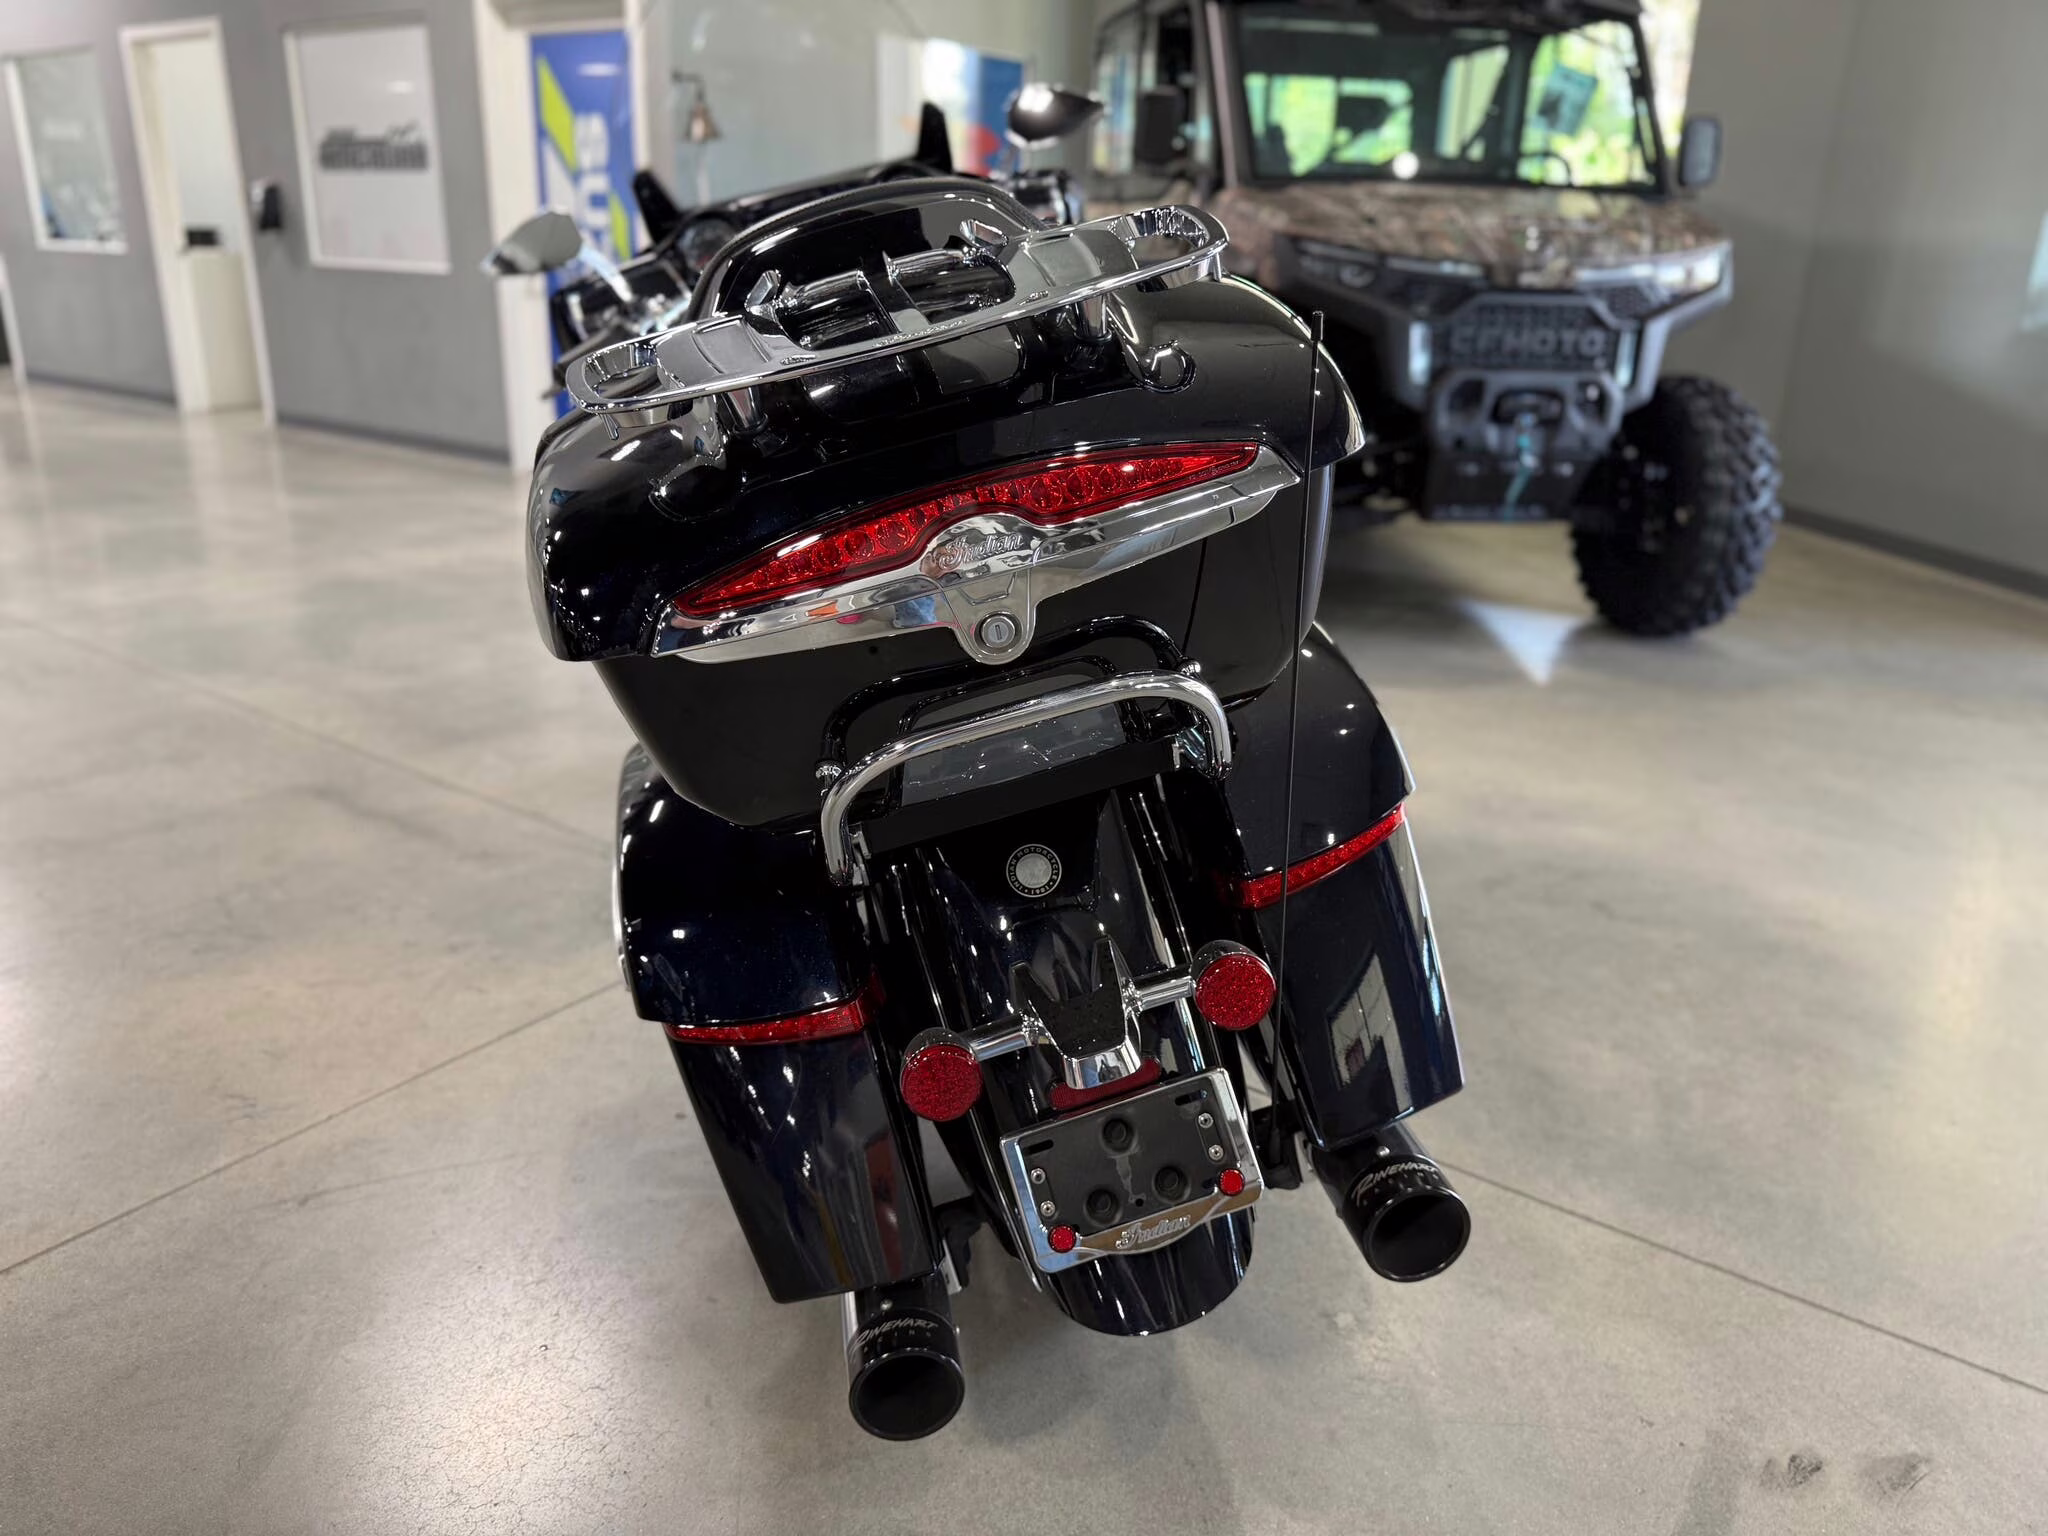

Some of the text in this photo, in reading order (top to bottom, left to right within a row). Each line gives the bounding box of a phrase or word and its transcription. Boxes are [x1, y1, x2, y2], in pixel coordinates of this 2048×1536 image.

[1450, 325, 1607, 357] CFMOTO
[938, 533, 1026, 571] Indian
[1009, 846, 1059, 891] INDIAN MOTORCYCLE
[1115, 1214, 1192, 1250] Indian
